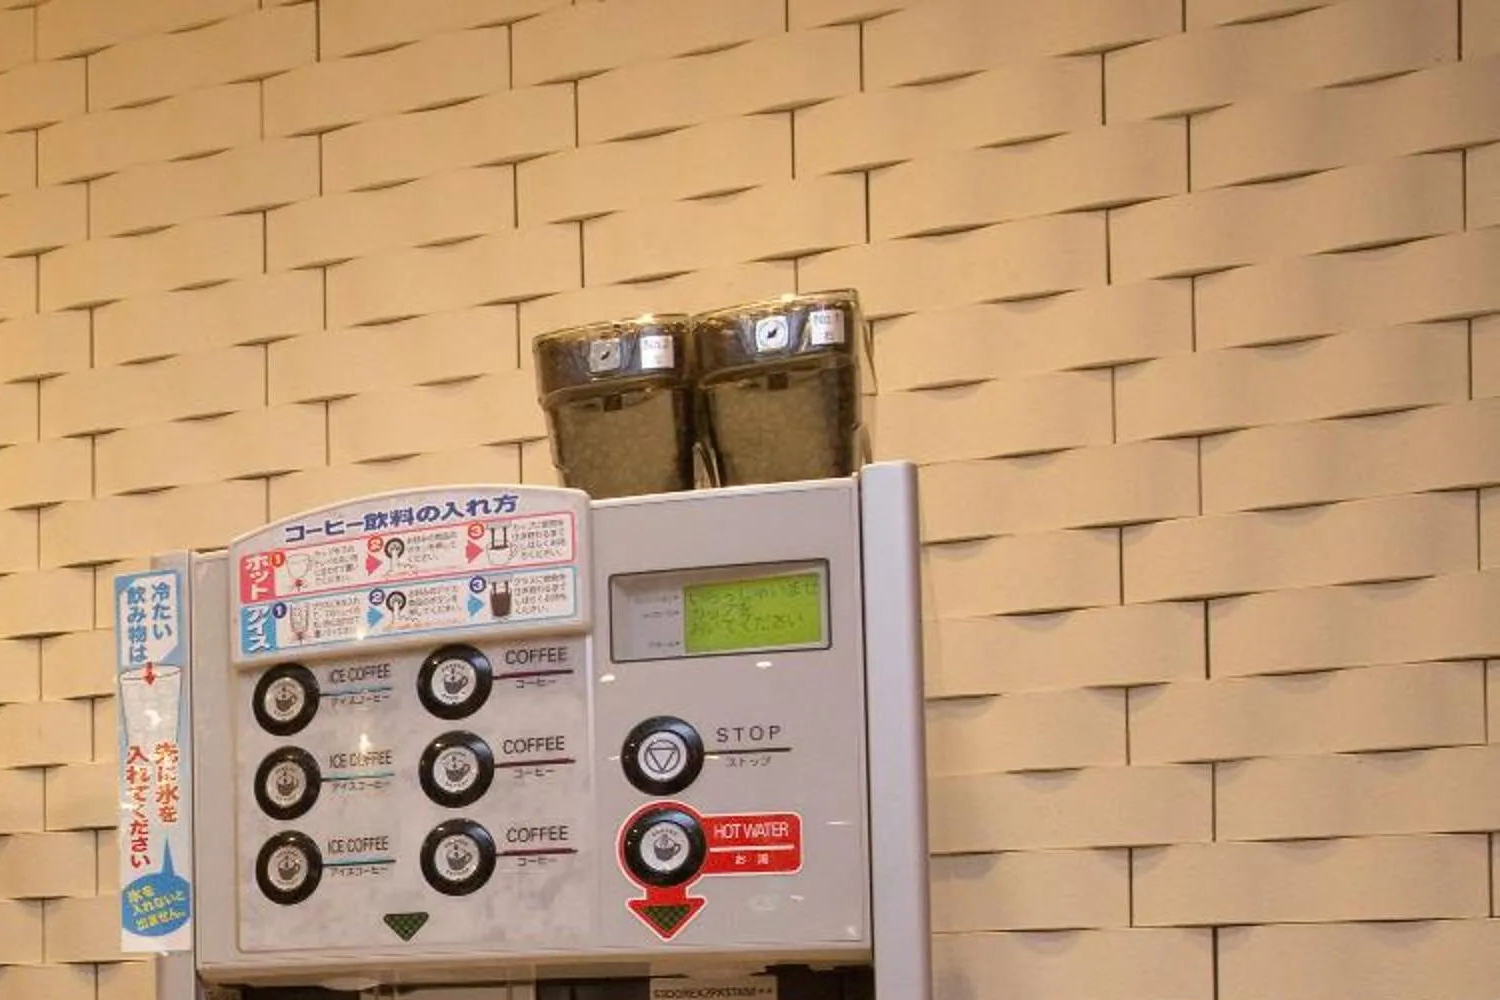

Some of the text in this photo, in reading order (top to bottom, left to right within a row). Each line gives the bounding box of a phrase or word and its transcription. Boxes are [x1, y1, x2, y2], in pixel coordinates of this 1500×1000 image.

[284, 493, 519, 543] コーヒー飲料の入れ方
[245, 554, 269, 601] ホット
[150, 581, 173, 641] 冷たい
[126, 585, 150, 664] 飲み物は
[247, 607, 271, 653] アイス
[505, 646, 569, 666] COFFEE
[348, 663, 391, 682] COFFEE
[515, 678, 557, 690] コーヒー
[715, 724, 782, 743] STOP
[502, 735, 566, 755] COFFEE
[329, 749, 393, 769] ICE COFFEE
[726, 756, 772, 768] ストップ
[153, 741, 180, 824] 先に氷を
[513, 767, 555, 779] コーヒー
[125, 745, 151, 869] 入れてください
[505, 825, 570, 844] COFFEE
[713, 822, 789, 840] HOT WATER
[327, 835, 389, 855] ICE COFFEE
[516, 856, 558, 868] コーヒー
[329, 866, 389, 879] アイスコーヒー
[127, 885, 154, 903] 氷を
[133, 890, 186, 917] 入れないと
